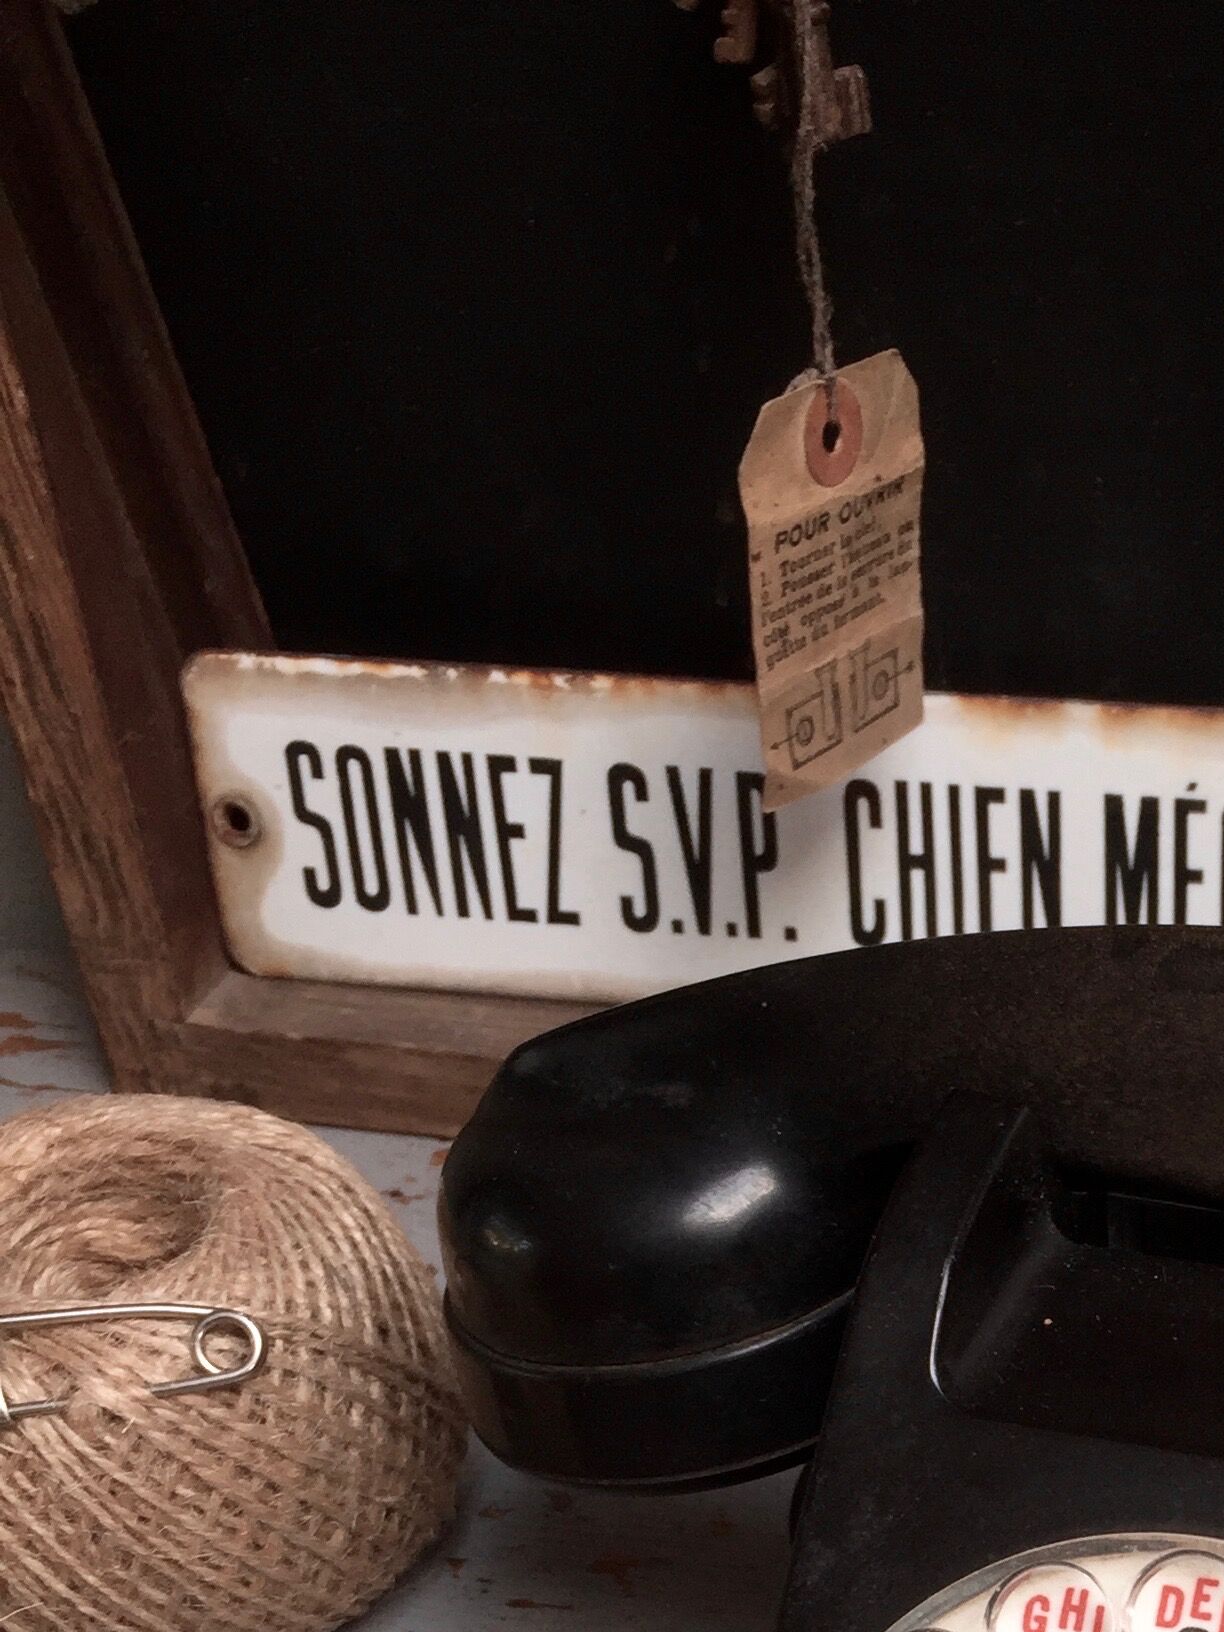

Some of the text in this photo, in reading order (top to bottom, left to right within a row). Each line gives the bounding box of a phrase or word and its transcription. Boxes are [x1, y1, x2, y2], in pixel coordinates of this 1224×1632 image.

[774, 511, 831, 553] POUR
[285, 740, 581, 926] SONNEZ
[607, 762, 798, 943] S.V.P.
[844, 779, 1062, 947] CHIEN
